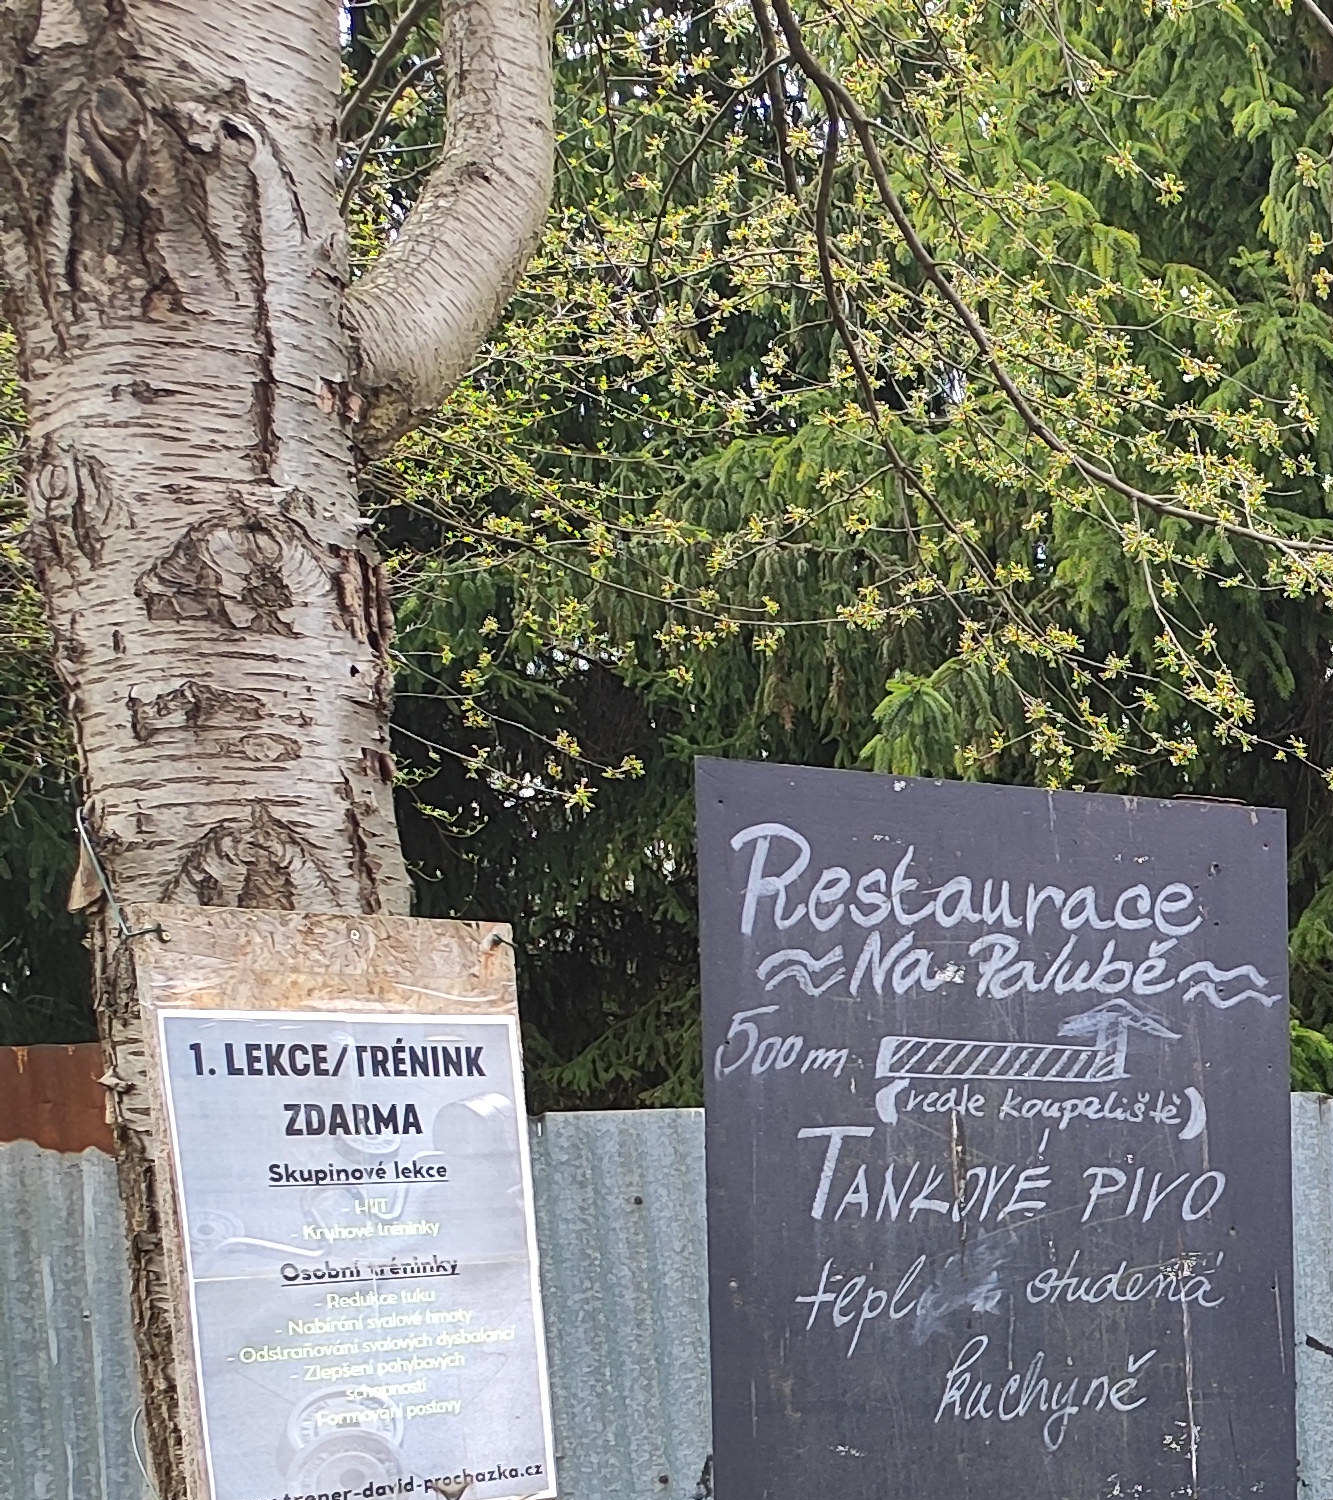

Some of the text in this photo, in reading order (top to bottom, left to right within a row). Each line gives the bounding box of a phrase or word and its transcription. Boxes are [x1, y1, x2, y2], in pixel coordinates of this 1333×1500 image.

[730, 822, 1203, 935] Restaurace
[849, 930, 1180, 999] Na Palubě
[190, 1042, 216, 1076] 1.
[284, 1103, 423, 1136] ZDARMA
[268, 1161, 447, 1184] Skupinové lekce
[1081, 1166, 1226, 1223] PIVO
[281, 1260, 361, 1282] Osobní
[1026, 1250, 1226, 1308] studená
[327, 1289, 436, 1310] Redukce tuku
[367, 1311, 422, 1329] svalové
[426, 1308, 473, 1327] hmoty
[303, 1361, 374, 1382] Zlepšení
[407, 1399, 462, 1419] postavy
[934, 1335, 1158, 1451] kuchyně
